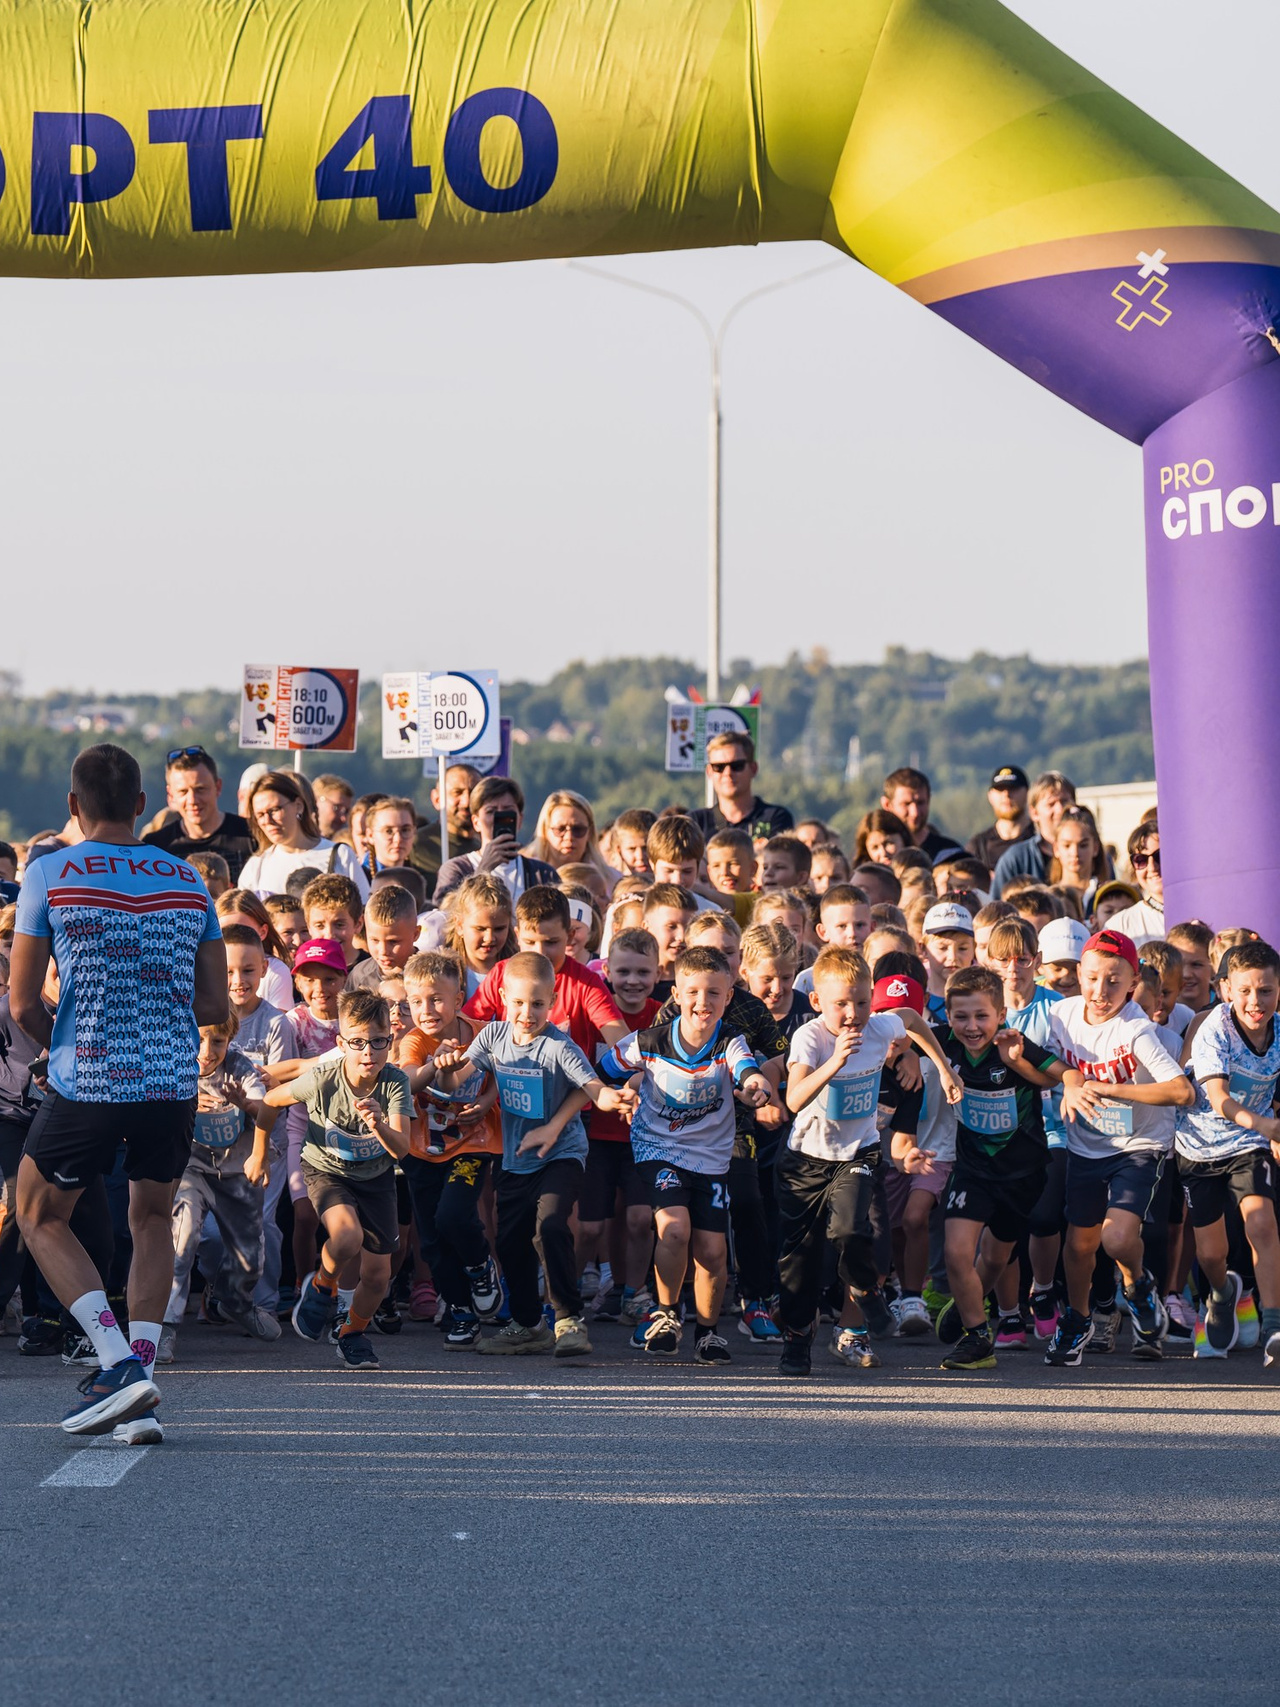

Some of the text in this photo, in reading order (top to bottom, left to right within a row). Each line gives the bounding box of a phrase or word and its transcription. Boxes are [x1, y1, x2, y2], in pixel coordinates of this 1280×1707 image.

[314, 86, 559, 222] 40
[1160, 458, 1214, 495] PRO
[1162, 482, 1280, 540] СПО
[294, 688, 328, 702] 18:10
[434, 693, 467, 706] 18:00
[276, 666, 294, 749] ДЕТСКИЙ СТАРТ
[506, 1079, 524, 1090] ГЛЕБ
[687, 1081, 705, 1090] ЕГОР
[843, 1078, 875, 1094] ТИМОФЕЙ
[503, 1089, 531, 1112] 869
[675, 1085, 717, 1105] 2643
[843, 1091, 873, 1115] 258
[968, 1099, 1009, 1110] СВЯТОСЛАВ
[210, 1117, 229, 1125] ГЛЕБ
[969, 1109, 1012, 1130] 3706
[202, 1119, 241, 1142] 5181
[351, 1138, 379, 1147] ДМИТР
[947, 1190, 967, 1210] 24
